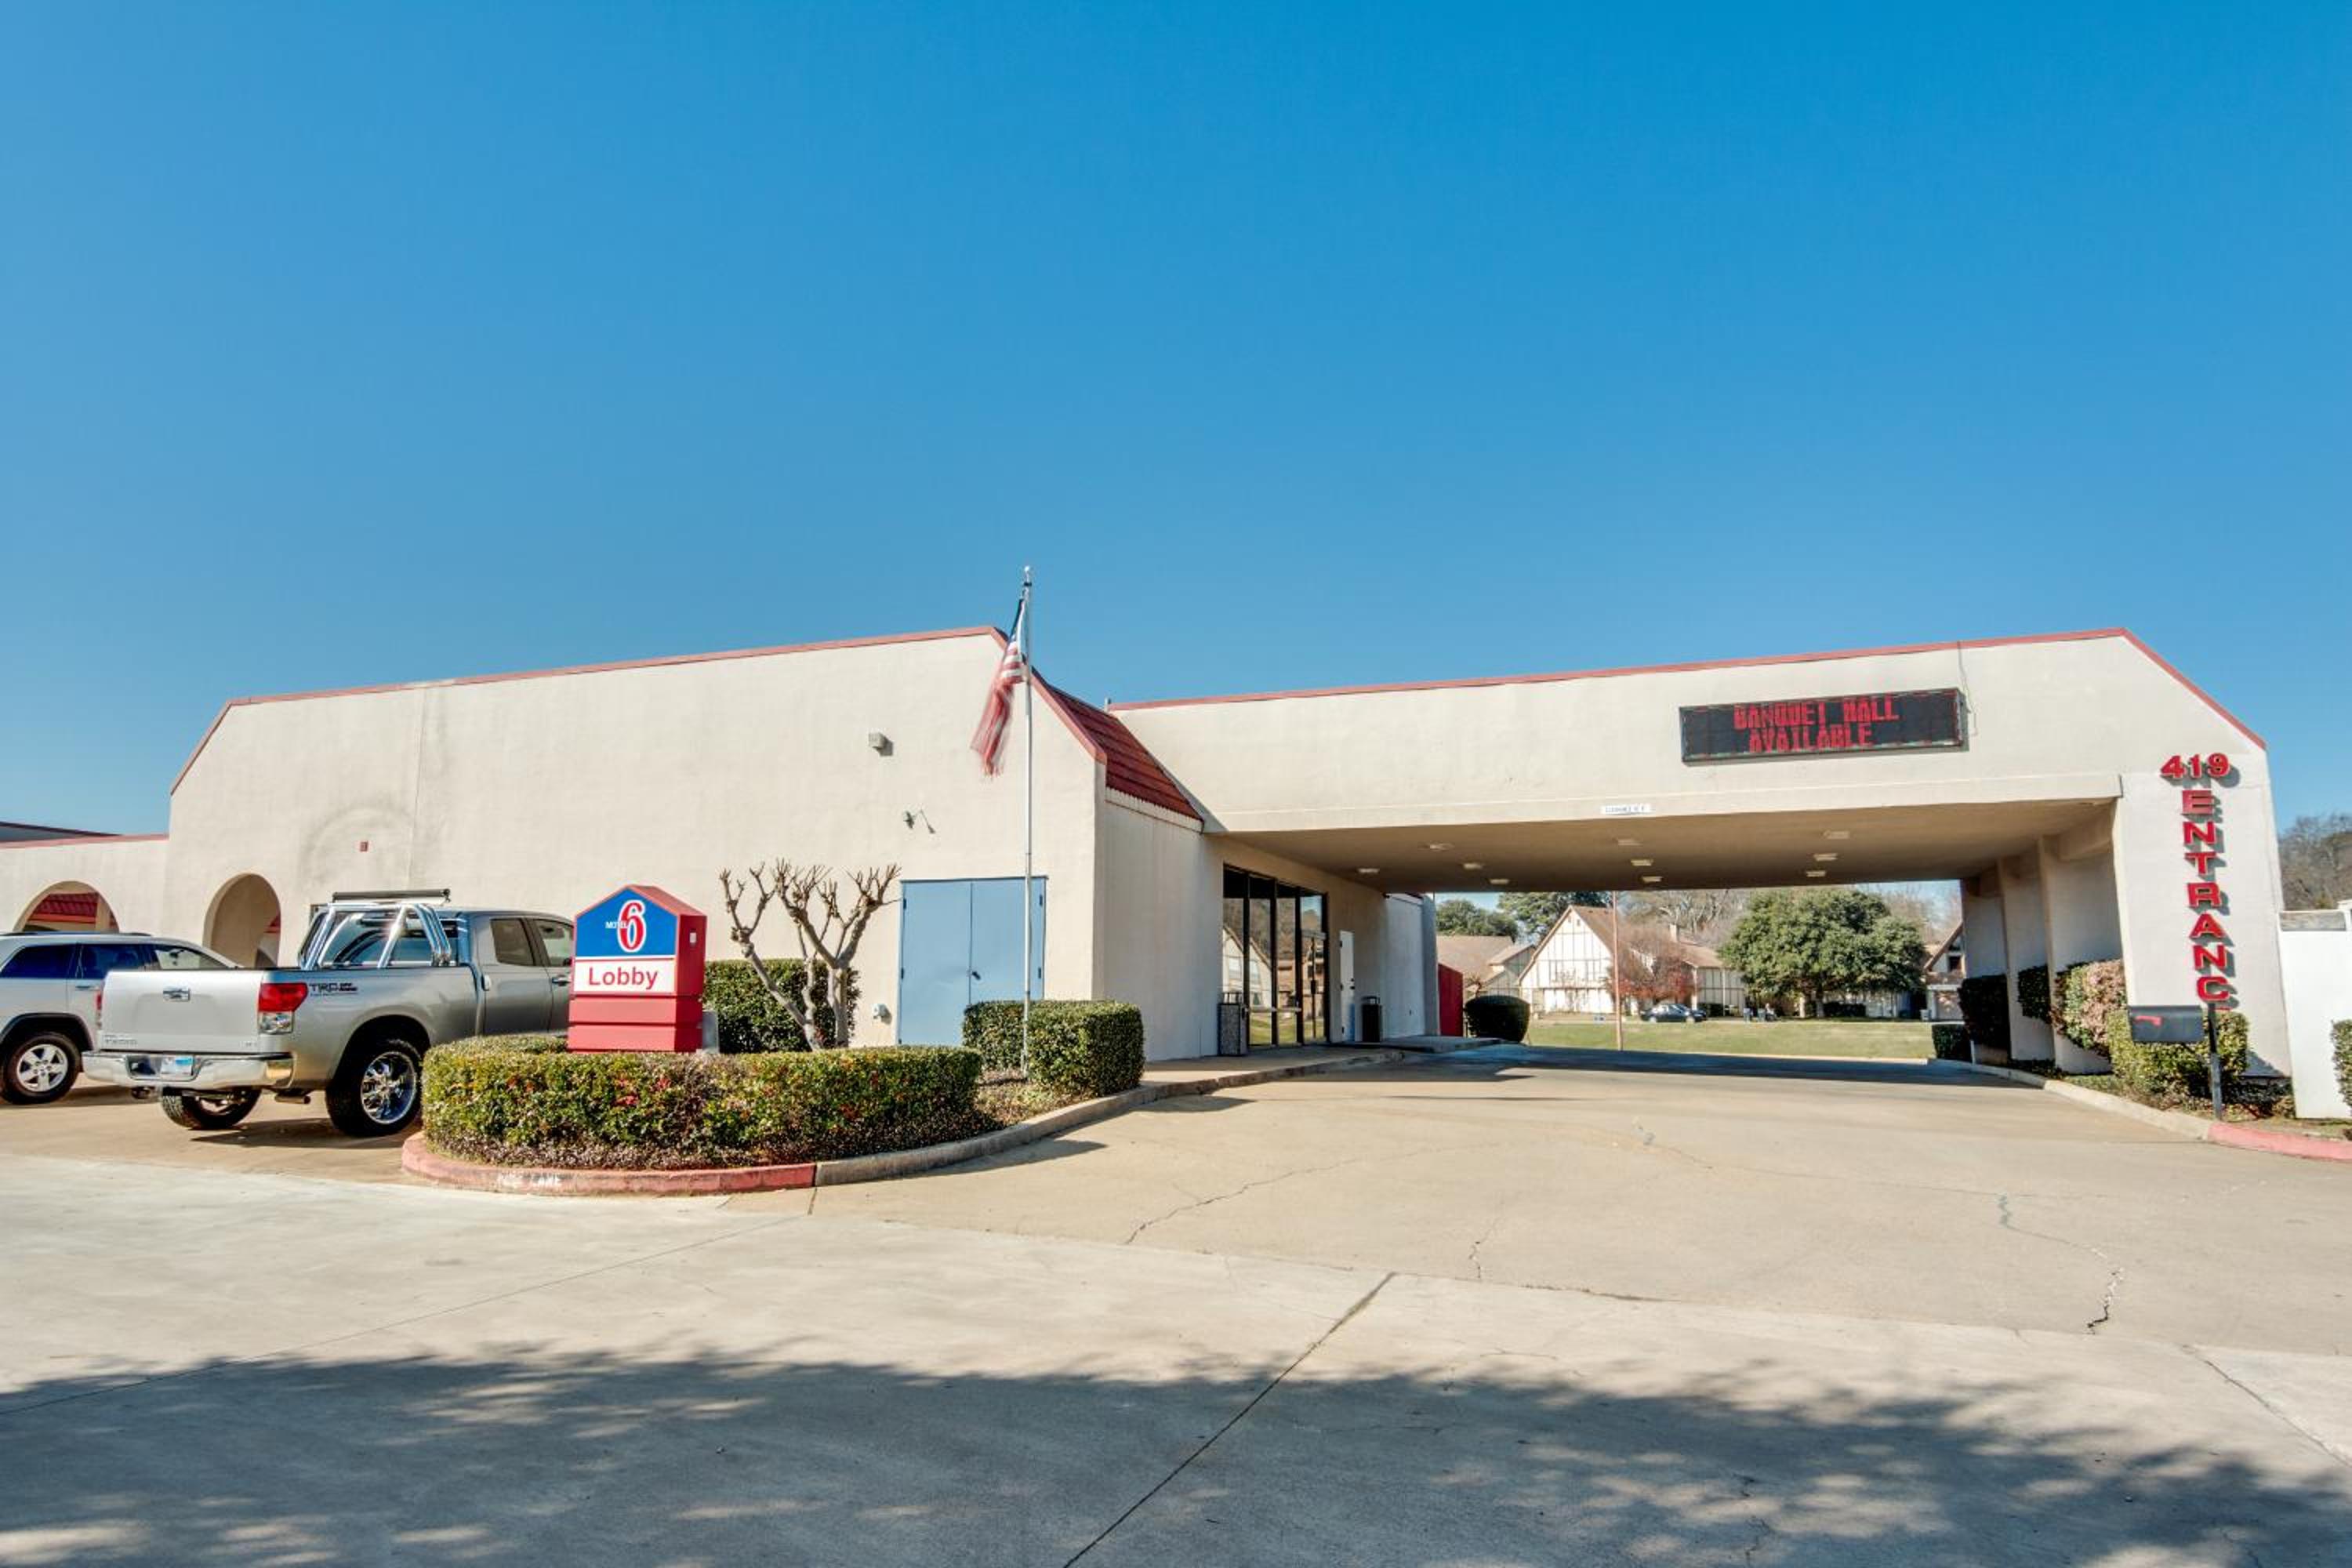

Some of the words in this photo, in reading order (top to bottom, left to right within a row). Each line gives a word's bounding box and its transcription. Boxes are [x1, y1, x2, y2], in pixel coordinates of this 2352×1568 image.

[1734, 700, 1826, 729] BANQUET
[1843, 695, 1899, 722] HALL
[1748, 723, 1873, 753] AVAILABLE
[2160, 753, 2230, 779] 419
[2181, 789, 2231, 1012] ENTRANC
[605, 920, 629, 929] MOTEL
[617, 900, 647, 953] 6
[588, 967, 659, 990] Lobby
